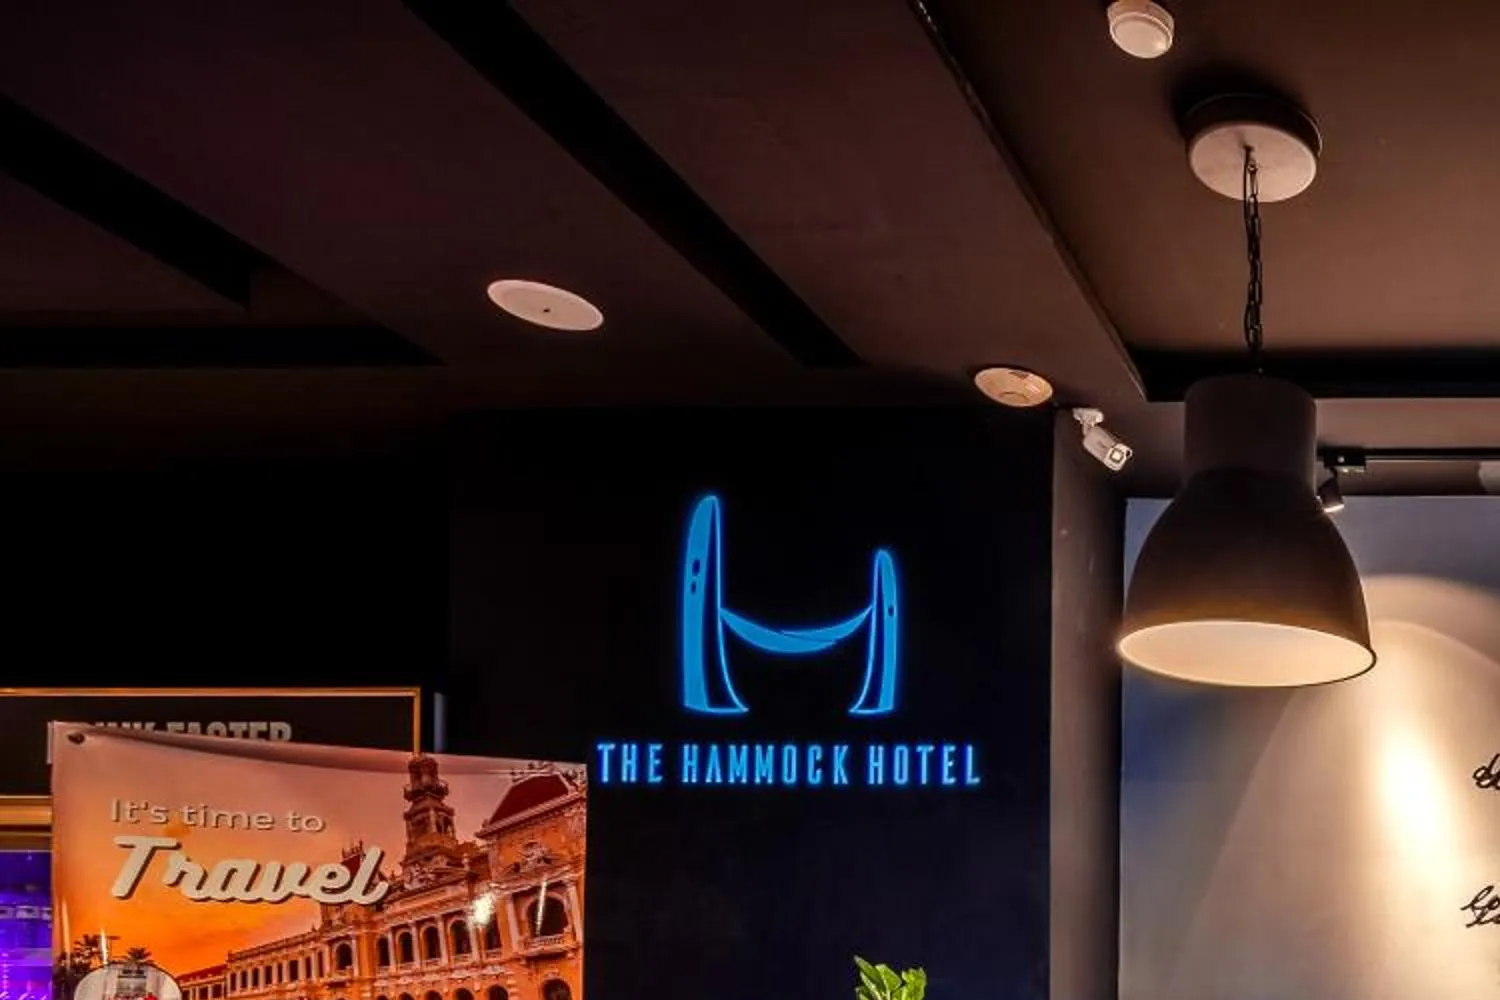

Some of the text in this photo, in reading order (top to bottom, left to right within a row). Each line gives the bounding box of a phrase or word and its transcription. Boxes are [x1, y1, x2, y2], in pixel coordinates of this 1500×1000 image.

[597, 743, 981, 785] THE HAMMOCK HOTEL
[111, 799, 326, 833] It's time to
[111, 835, 389, 905] Travel
